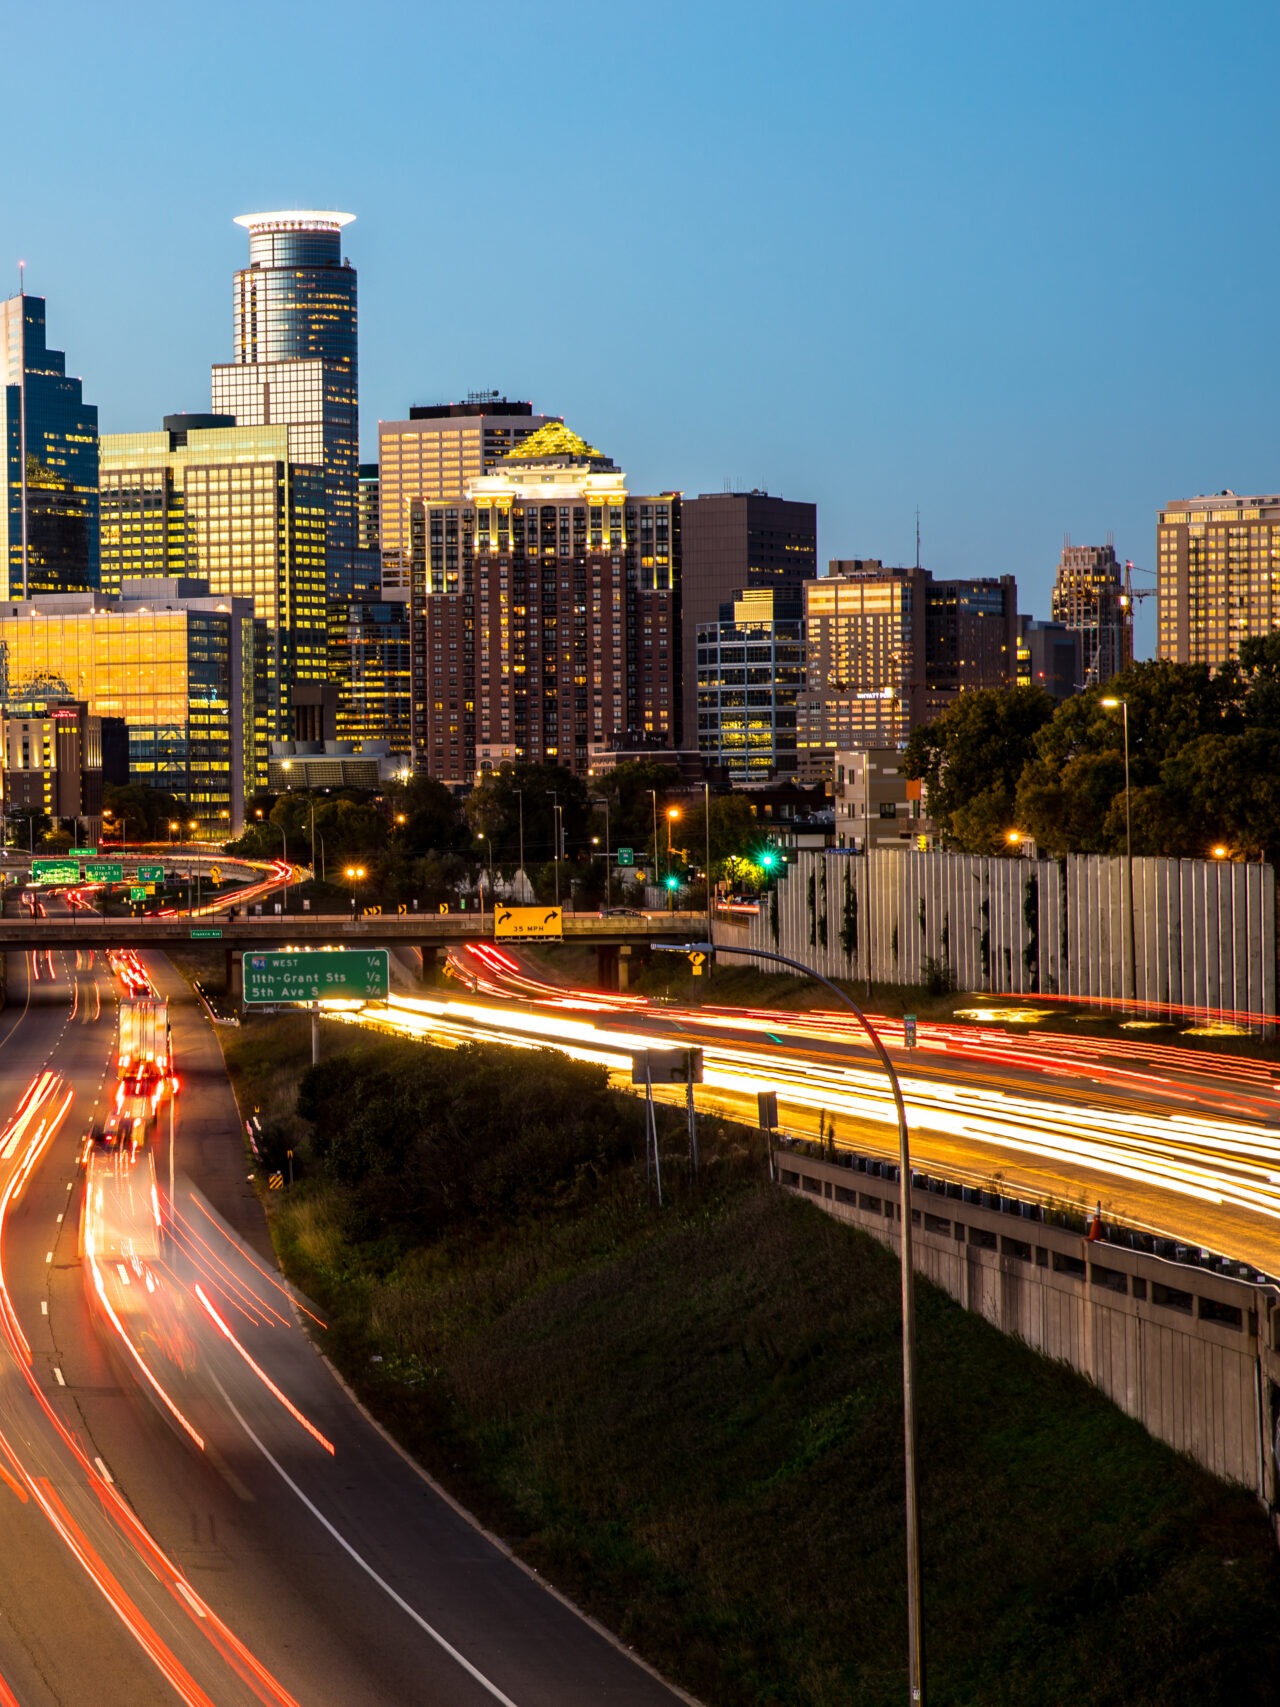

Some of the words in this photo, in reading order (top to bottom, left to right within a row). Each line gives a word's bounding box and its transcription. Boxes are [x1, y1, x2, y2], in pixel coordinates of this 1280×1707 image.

[272, 959, 299, 967] WEST
[367, 956, 381, 967] 1/4
[251, 973, 319, 984] 11th-Grant
[326, 972, 347, 983] Sts
[366, 972, 381, 982] 1/2
[251, 987, 274, 997] 5th
[281, 987, 305, 996] Ave
[311, 986, 319, 996] S
[365, 985, 381, 995] 3/4
